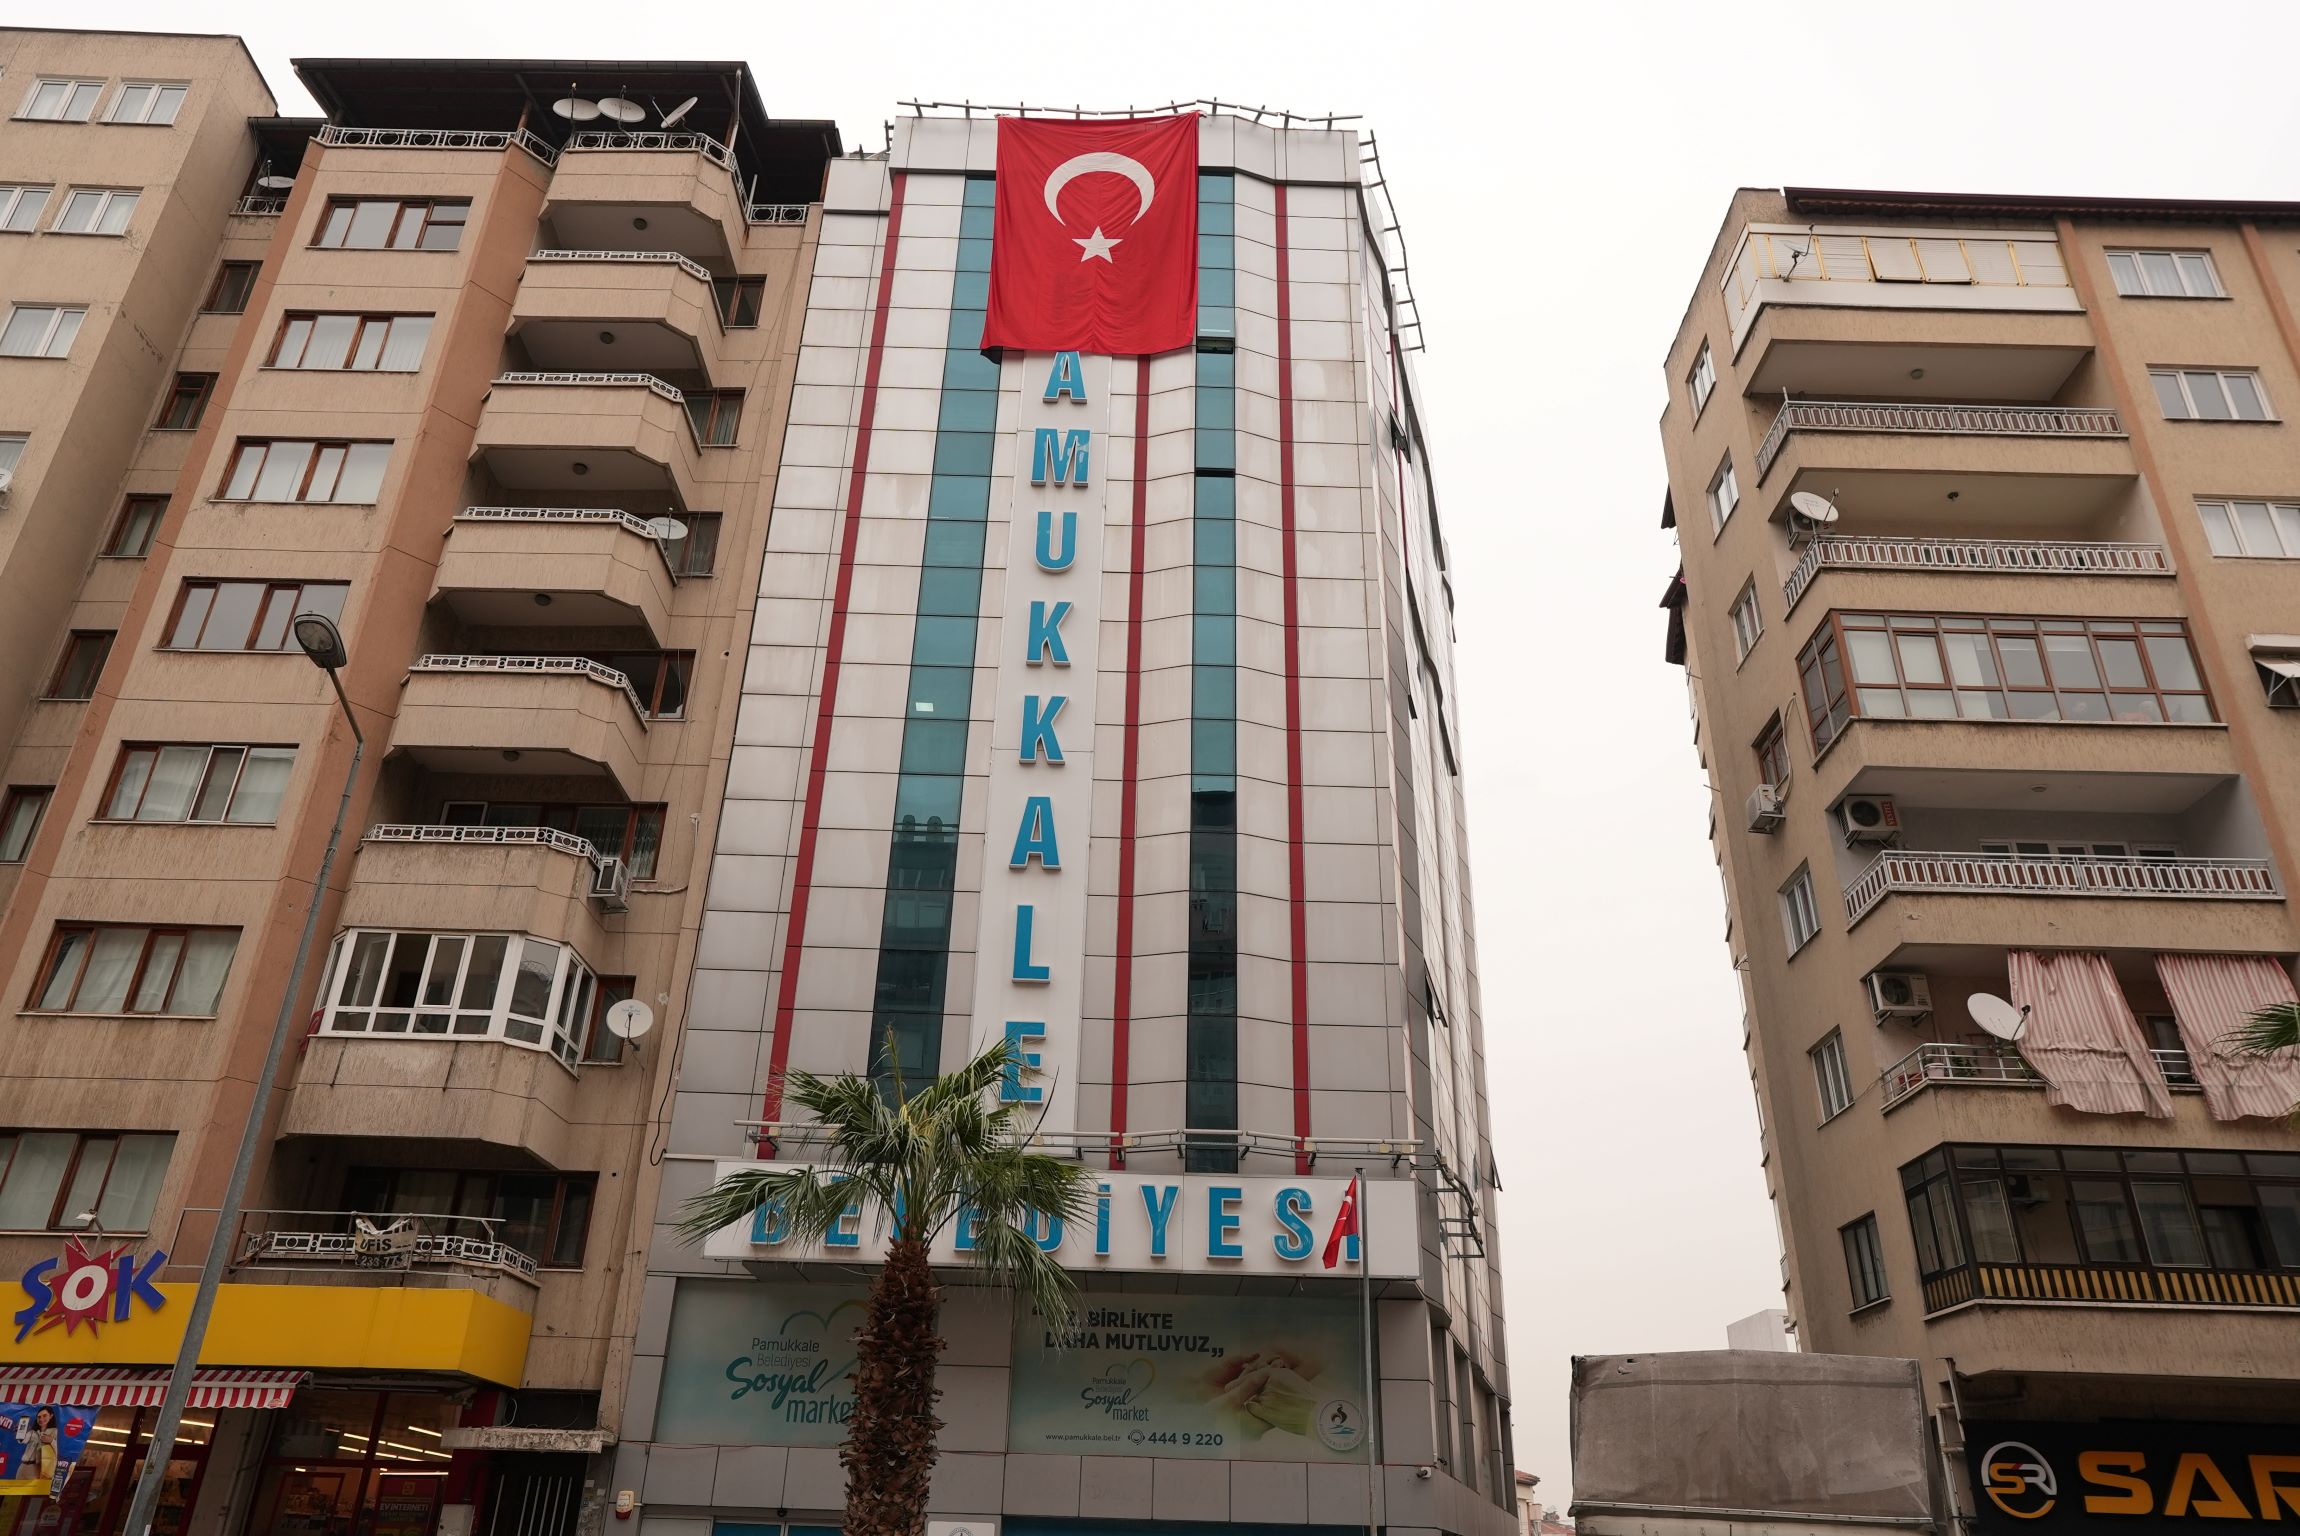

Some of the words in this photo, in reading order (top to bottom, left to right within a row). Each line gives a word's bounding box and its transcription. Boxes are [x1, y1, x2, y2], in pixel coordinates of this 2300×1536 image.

[14, 1249, 167, 1343] ŞOK
[1087, 1307, 1173, 1330] BİRLİKTE
[751, 1337, 820, 1353] Pamukkale
[756, 1352, 811, 1370] Belediyesi
[725, 1356, 829, 1410] Sosyal
[1092, 1376, 1127, 1386] Pamukkale
[785, 1393, 859, 1425] marke
[1080, 1387, 1132, 1414] Sosyal
[1112, 1405, 1150, 1422] market
[1045, 1433, 1122, 1442] www.pamukkale.bel.tr
[1148, 1431, 1177, 1445] 444
[1182, 1432, 1191, 1446] 9
[1195, 1433, 1224, 1447] 220
